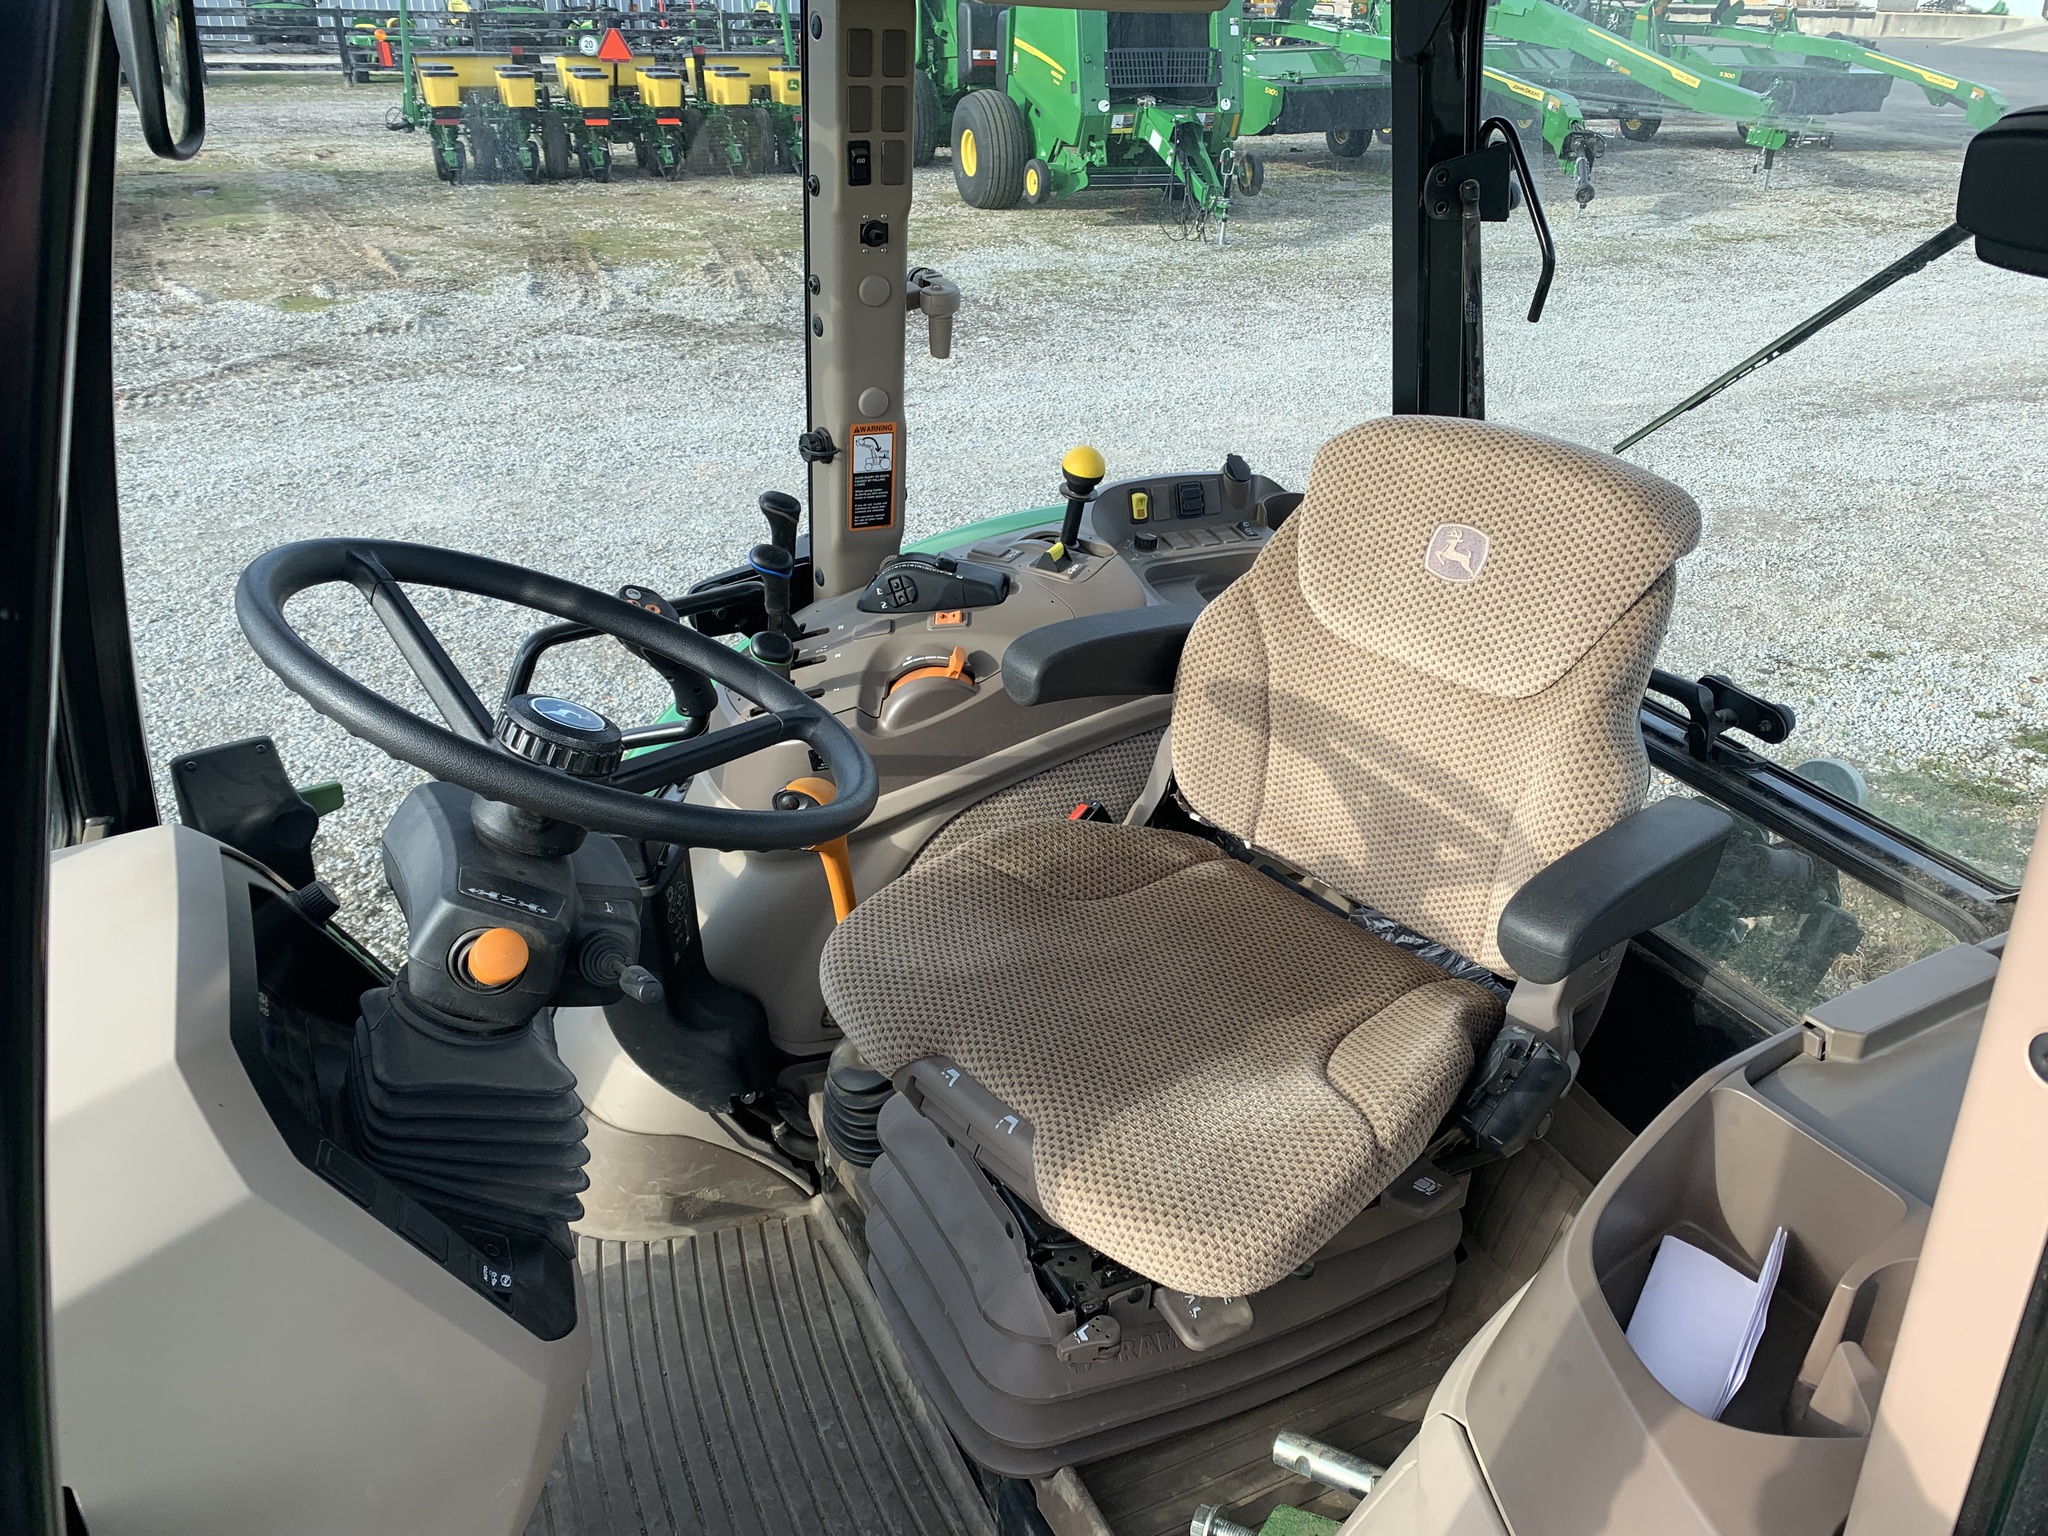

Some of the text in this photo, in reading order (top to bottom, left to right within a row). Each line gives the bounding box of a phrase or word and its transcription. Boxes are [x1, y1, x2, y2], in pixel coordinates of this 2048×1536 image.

[584, 40, 594, 48] 20
[1512, 84, 1541, 98] JOHN DEERE
[859, 424, 893, 432] WARNING
